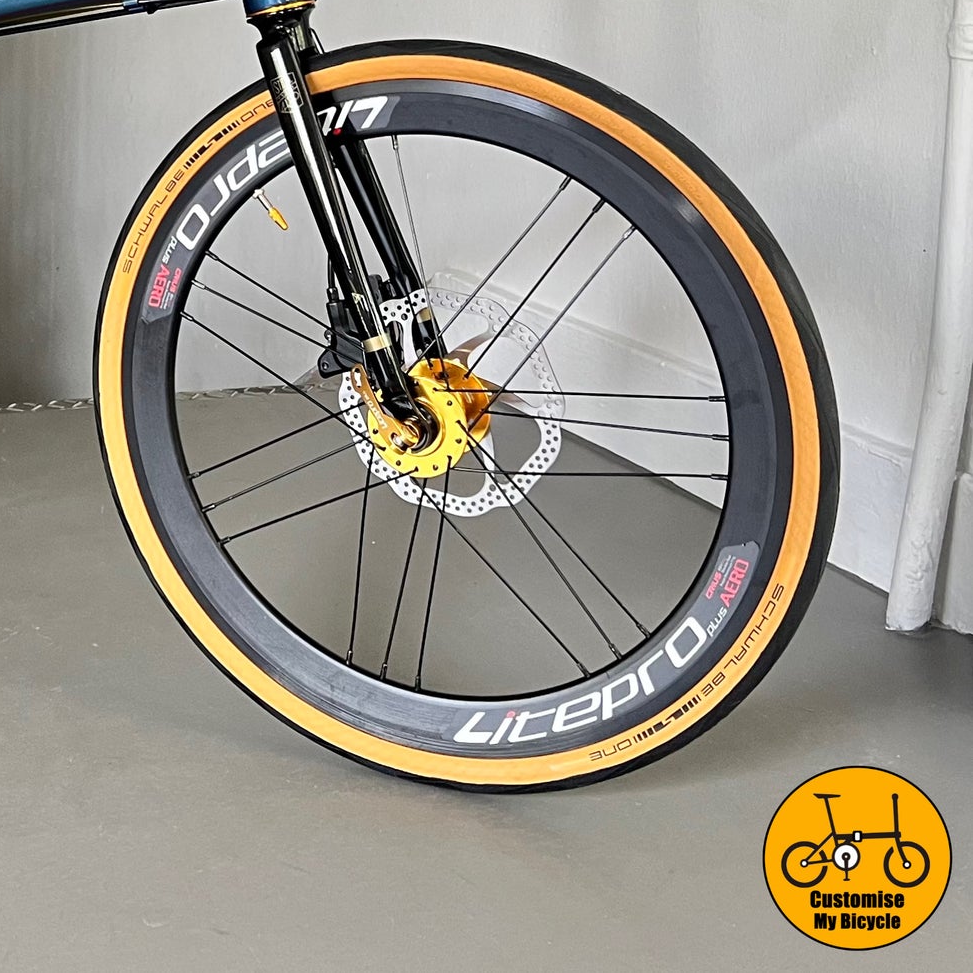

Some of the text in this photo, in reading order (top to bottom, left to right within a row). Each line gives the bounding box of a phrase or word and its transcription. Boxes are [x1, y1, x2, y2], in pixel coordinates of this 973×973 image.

[161, 235, 177, 265] plus
[148, 265, 171, 309] AERO
[719, 558, 750, 607] AERO
[453, 606, 729, 746] Litepro plus
[589, 737, 634, 762] ONE
